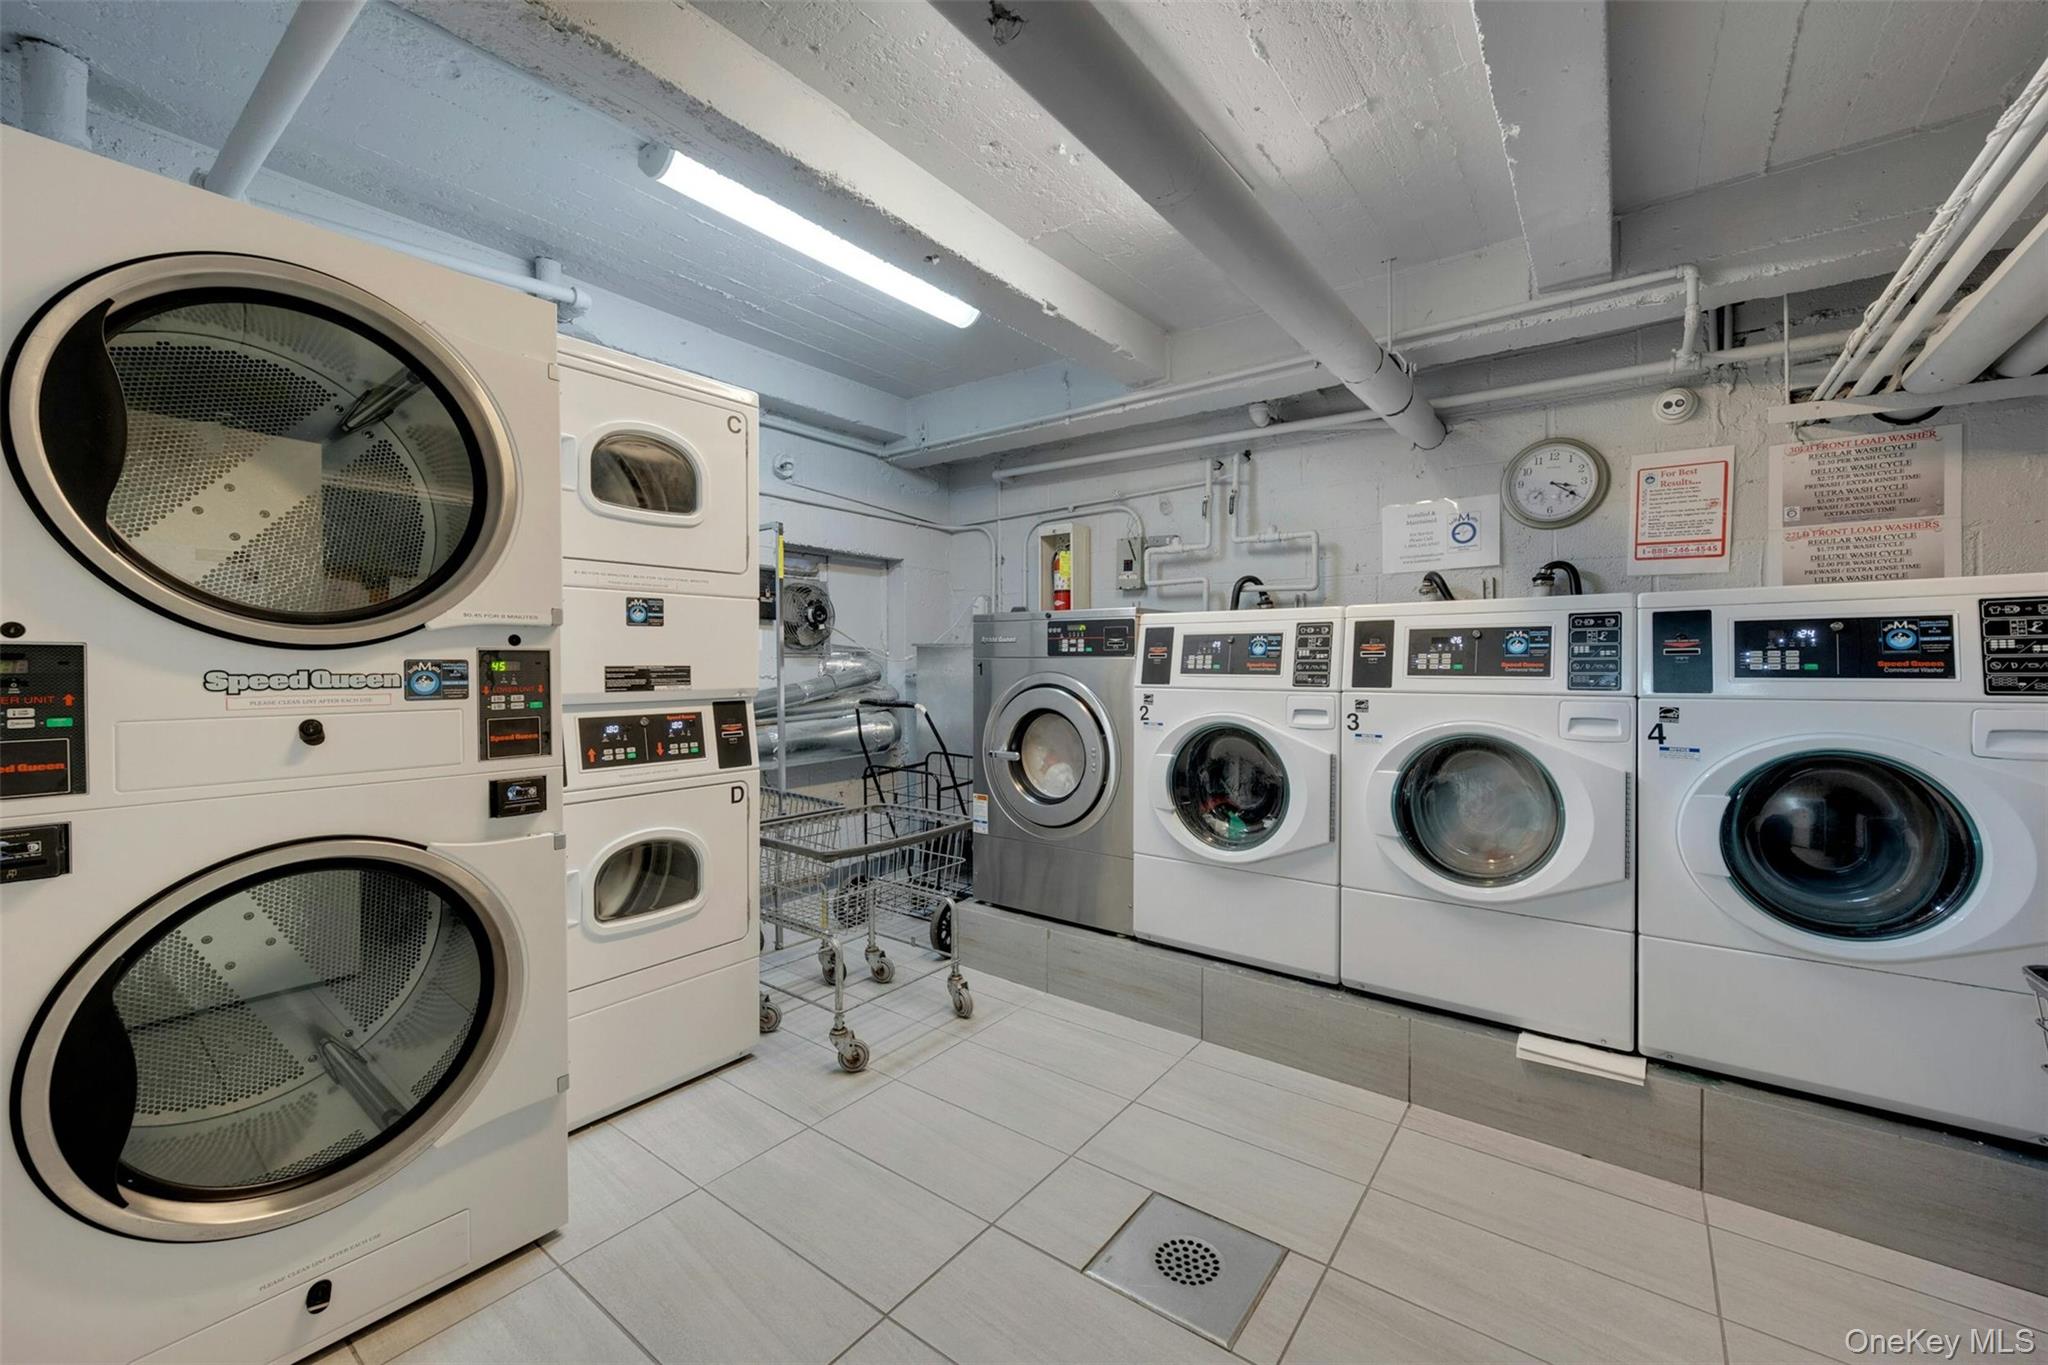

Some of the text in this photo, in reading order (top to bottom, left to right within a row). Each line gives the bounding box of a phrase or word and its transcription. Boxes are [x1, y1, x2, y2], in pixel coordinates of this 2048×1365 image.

[727, 416, 742, 434] C
[1814, 440, 1851, 450] FRONT
[1855, 436, 1885, 446] LOAD
[1888, 430, 1937, 442] WASHER
[1549, 452, 1560, 461] 12
[1808, 442, 1918, 460] REGULAR WASH CYCLE
[1853, 454, 1875, 462] WASH
[1877, 451, 1904, 459] CYCLE
[1535, 457, 1543, 465] 11
[1568, 455, 1573, 463] 1
[1522, 468, 1532, 477] 10
[1578, 464, 1585, 473] 2
[1660, 467, 1698, 478] For Best
[1811, 459, 1912, 476] DELUXE WASH CYCLE
[1877, 468, 1904, 476] CYCLE
[1581, 477, 1588, 485] 3
[1804, 481, 1841, 490] PREWASH
[1846, 478, 1873, 486] EXTRA
[1874, 475, 1899, 483] RINSE
[1900, 472, 1921, 480] TIME
[1814, 482, 1908, 498] ULTRA WASH CYCLE
[1853, 493, 1875, 501] WASH
[1877, 491, 1904, 499] CYCLE
[1546, 506, 1553, 514] 6
[1802, 503, 1839, 512] PREWASH
[1844, 501, 1871, 509] EXTRA
[1824, 505, 1897, 517] EXTRA RINSE TIME
[1812, 527, 1849, 537] FRONT
[1850, 525, 1882, 535] LOAD
[1885, 520, 1940, 531] WASHERS
[1808, 531, 1918, 546] REGULAR WASH CYCLE
[1877, 540, 1905, 548] CYCLE
[1810, 548, 1912, 562] DELUXE WASH CYCLE
[1877, 556, 1905, 564] CYCLE
[1804, 568, 1841, 576] PREWASH
[1901, 562, 1921, 570] TIME
[1814, 571, 1909, 584] ULTRA WASH CYCLE
[491, 661, 506, 671] 45
[977, 662, 983, 676] 1
[203, 669, 402, 696] Speed Queen
[23, 695, 55, 705] UNIT
[1139, 705, 1149, 721] 2
[1347, 713, 1360, 731] 3
[490, 734, 515, 742] Speed
[1647, 723, 1667, 744] 4
[17, 762, 65, 772] Queen
[730, 785, 745, 804] D
[328, 1247, 349, 1261] AFTER
